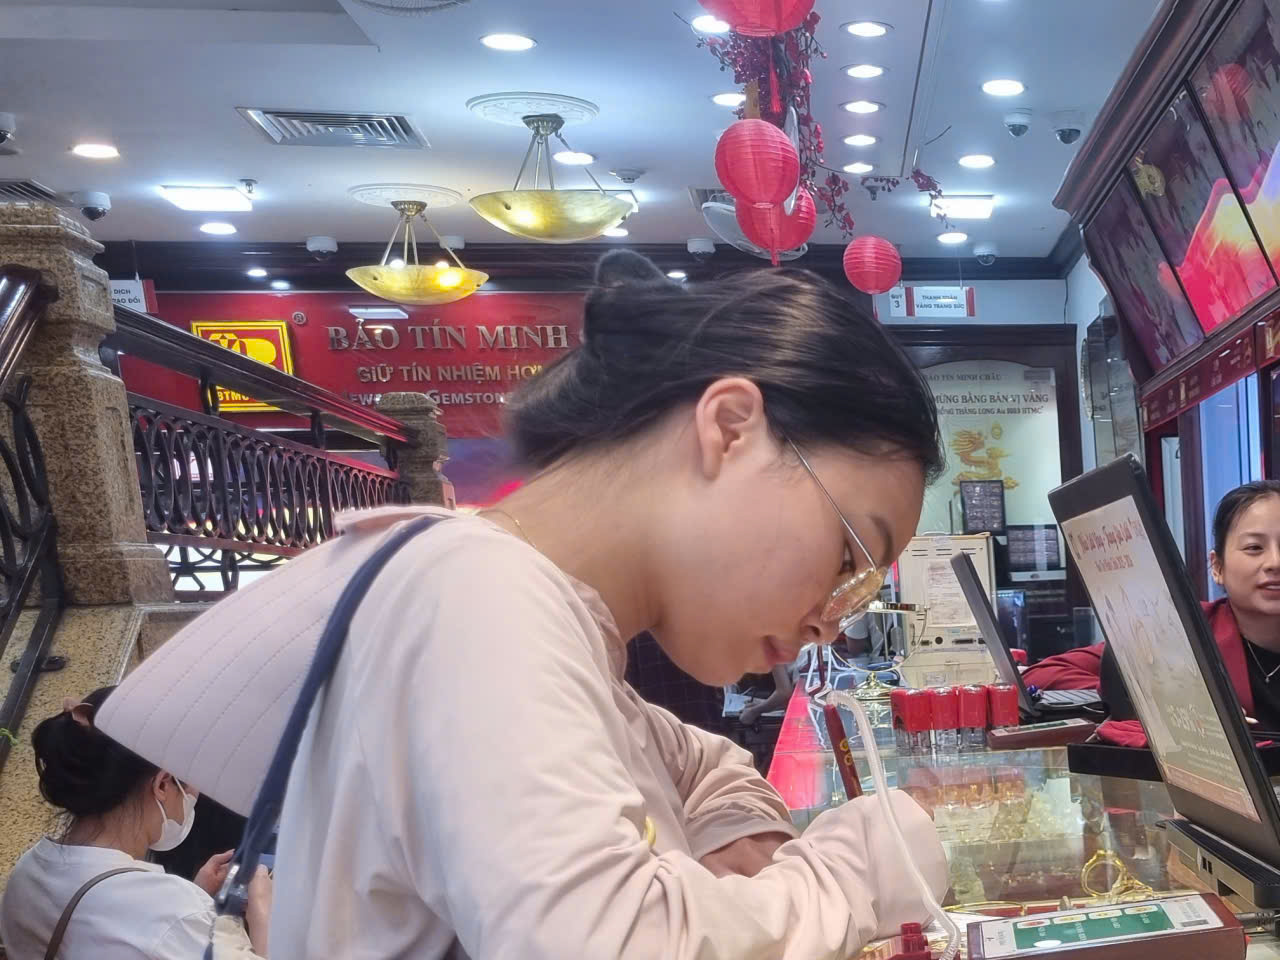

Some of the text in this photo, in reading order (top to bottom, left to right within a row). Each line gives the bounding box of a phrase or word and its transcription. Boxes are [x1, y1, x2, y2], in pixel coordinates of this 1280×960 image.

[327, 317, 569, 350] BẢO TÍN MINH
[399, 361, 432, 382] TÍN
[437, 362, 501, 385] NHIỆM
